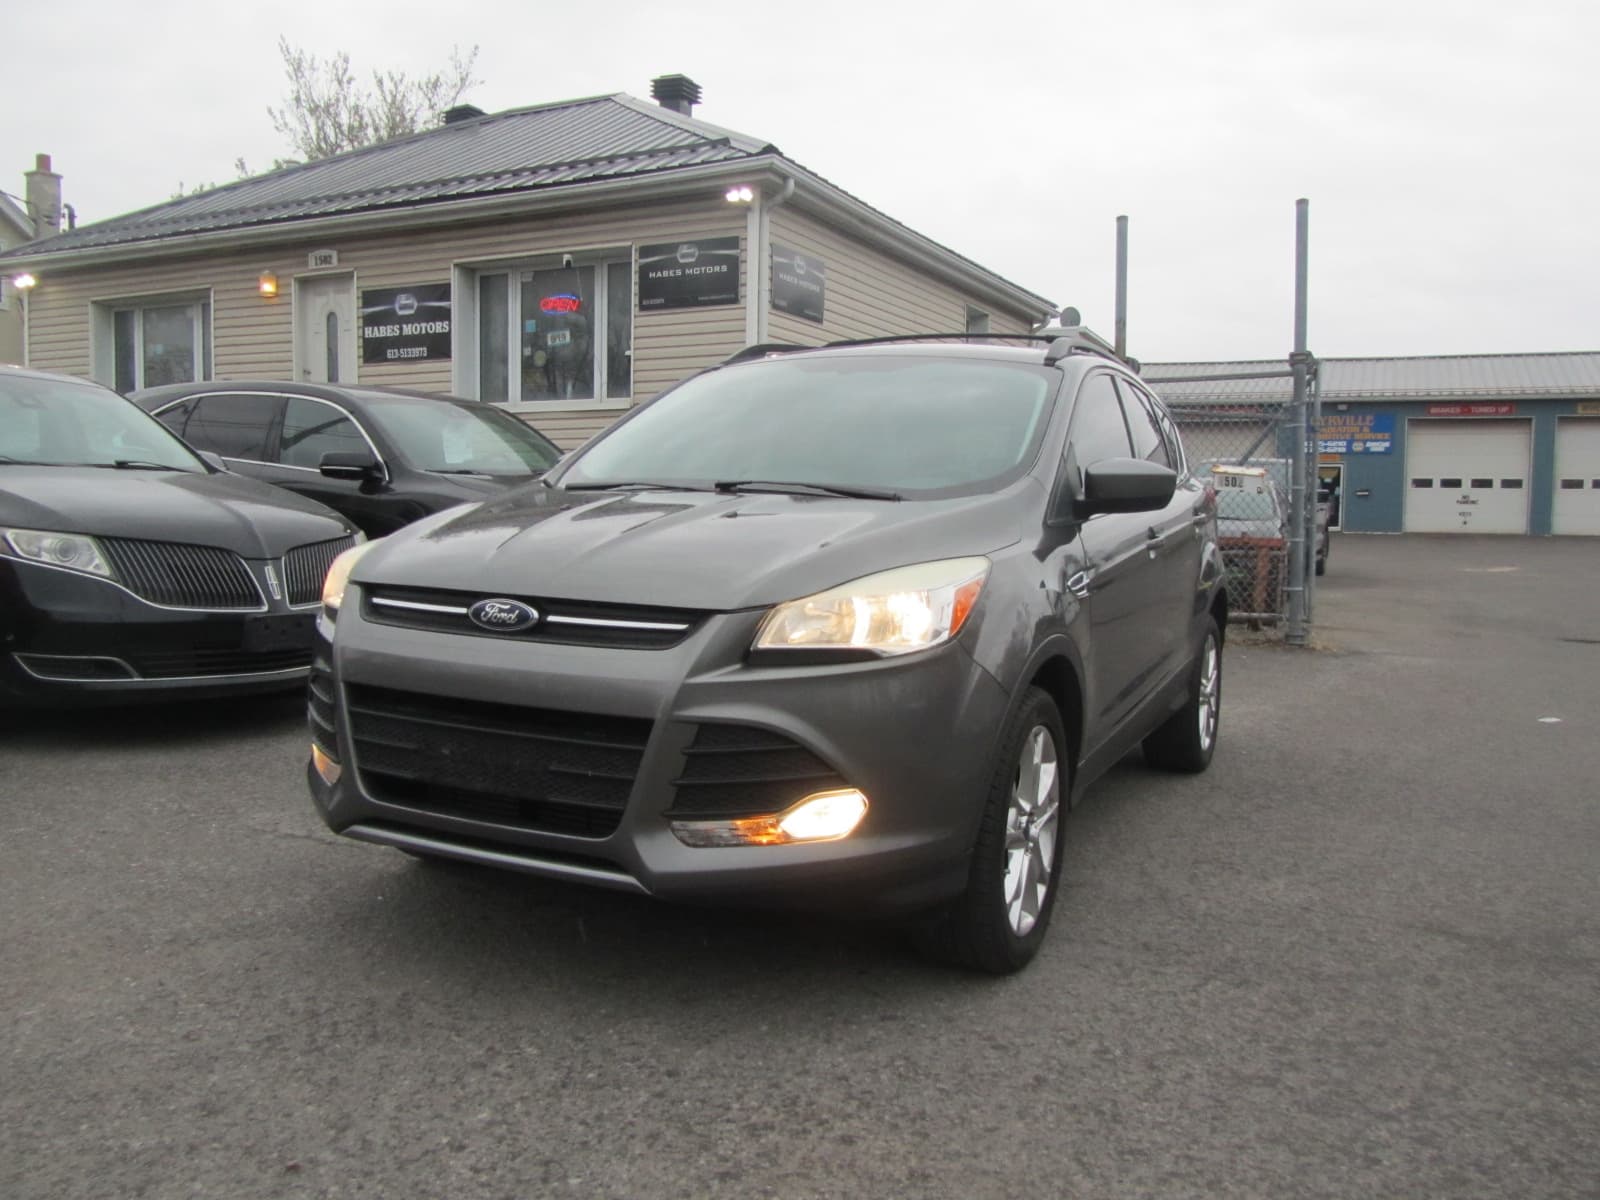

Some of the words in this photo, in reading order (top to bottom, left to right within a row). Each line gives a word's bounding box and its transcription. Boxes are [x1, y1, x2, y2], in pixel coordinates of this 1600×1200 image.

[648, 267, 682, 279] HABES
[685, 264, 729, 275] MOTORS
[540, 298, 580, 312] OPEN
[364, 324, 400, 338] HABES
[402, 320, 449, 336] MOTORS
[481, 602, 520, 624] Ford
